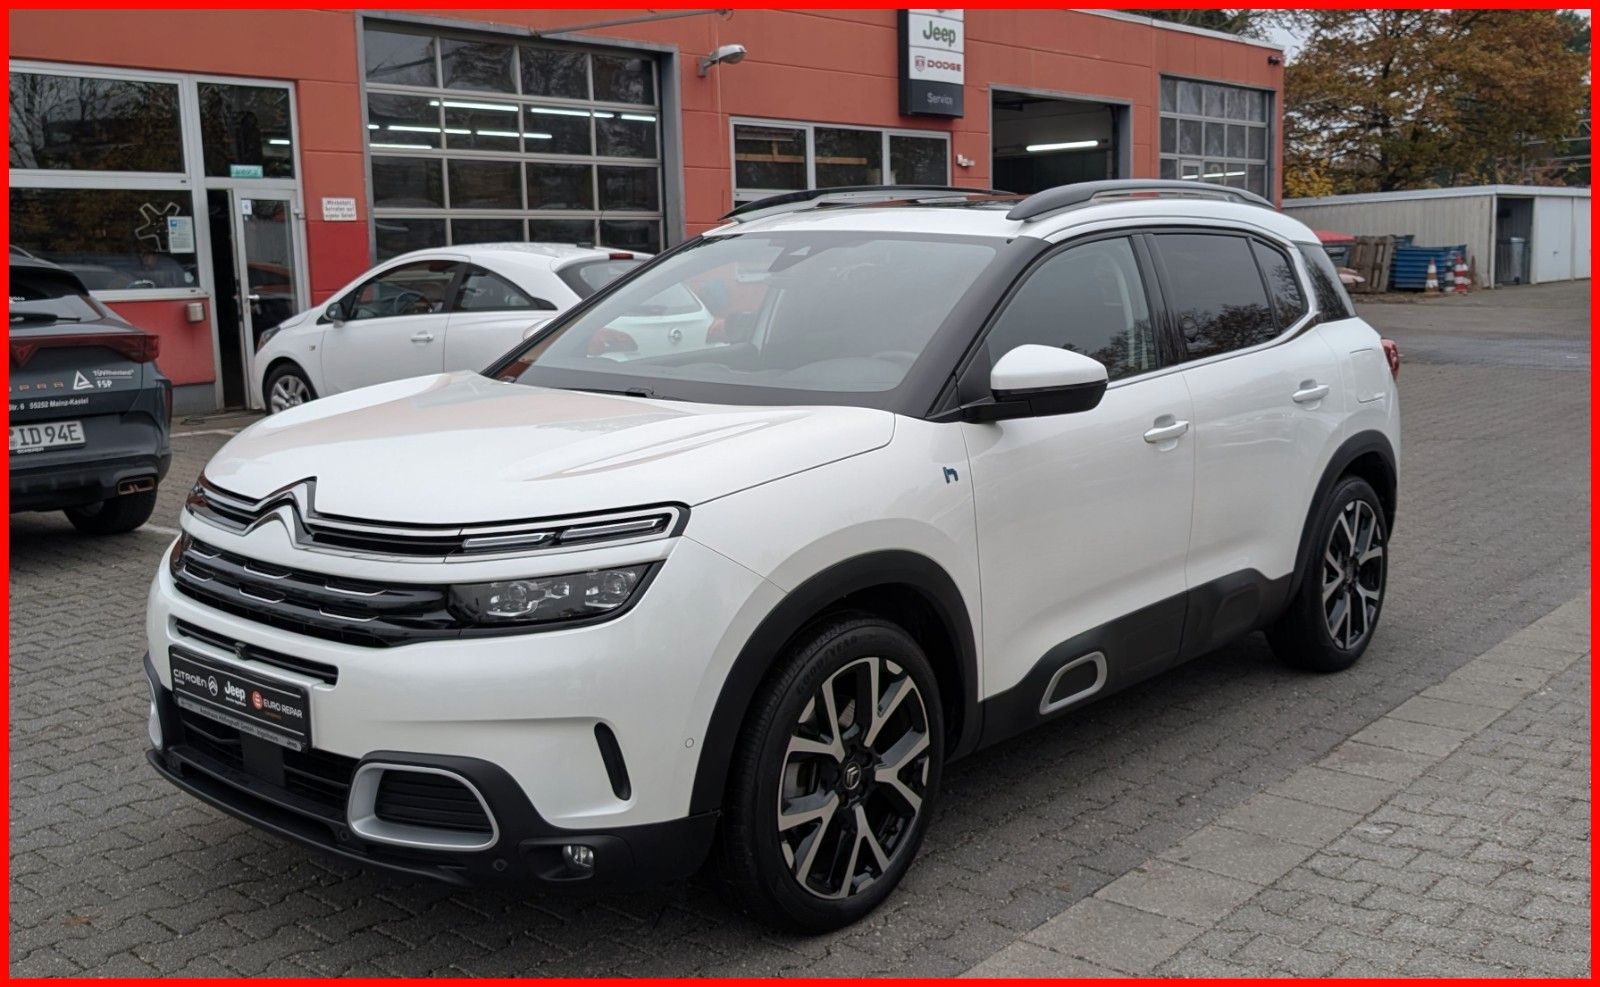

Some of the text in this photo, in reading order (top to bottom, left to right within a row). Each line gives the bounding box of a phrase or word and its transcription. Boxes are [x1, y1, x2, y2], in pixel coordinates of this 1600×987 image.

[922, 20, 956, 47] Jeep
[927, 60, 962, 72] DODGE
[926, 92, 953, 105] Service
[224, 680, 246, 701] Jeep
[263, 698, 281, 712] EURO
[281, 704, 303, 719] REPAR
